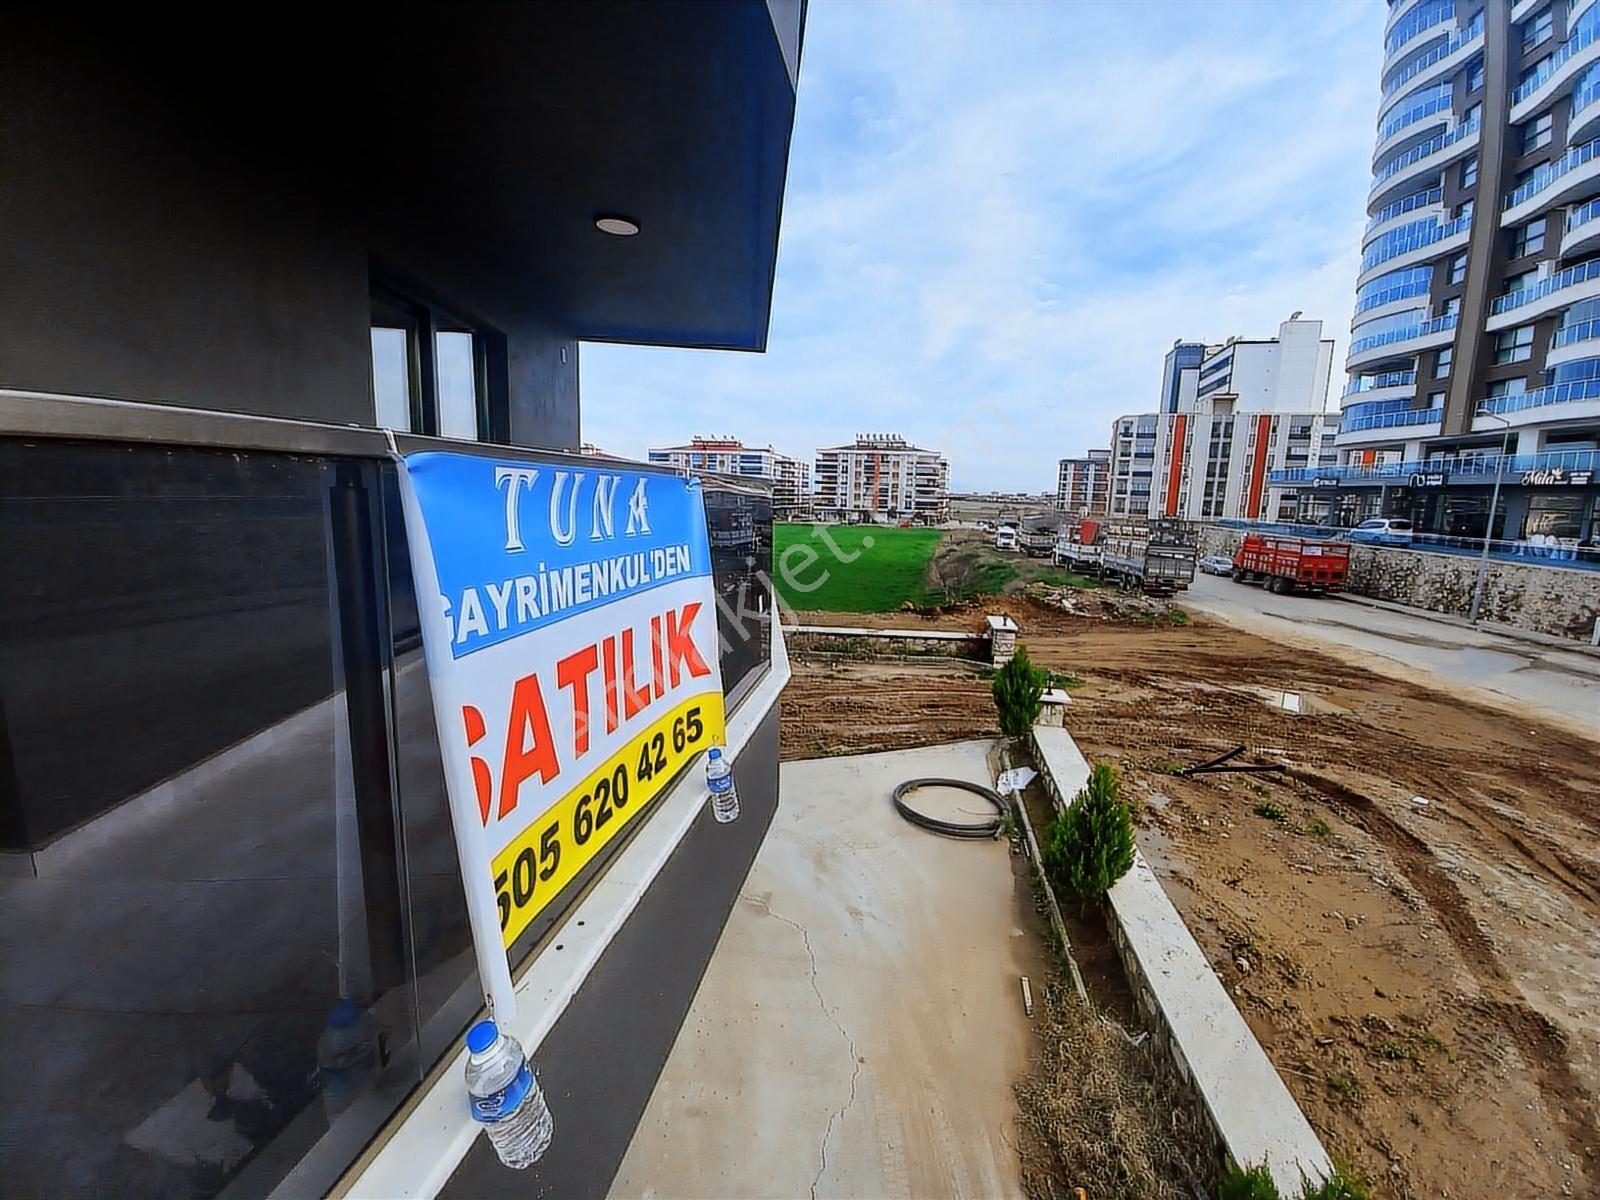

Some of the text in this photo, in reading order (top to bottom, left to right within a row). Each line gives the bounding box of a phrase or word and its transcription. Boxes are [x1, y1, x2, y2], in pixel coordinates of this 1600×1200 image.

[494, 466, 651, 553] TUNA
[573, 763, 629, 846] 620
[637, 732, 668, 783] 42
[673, 707, 703, 754] 65
